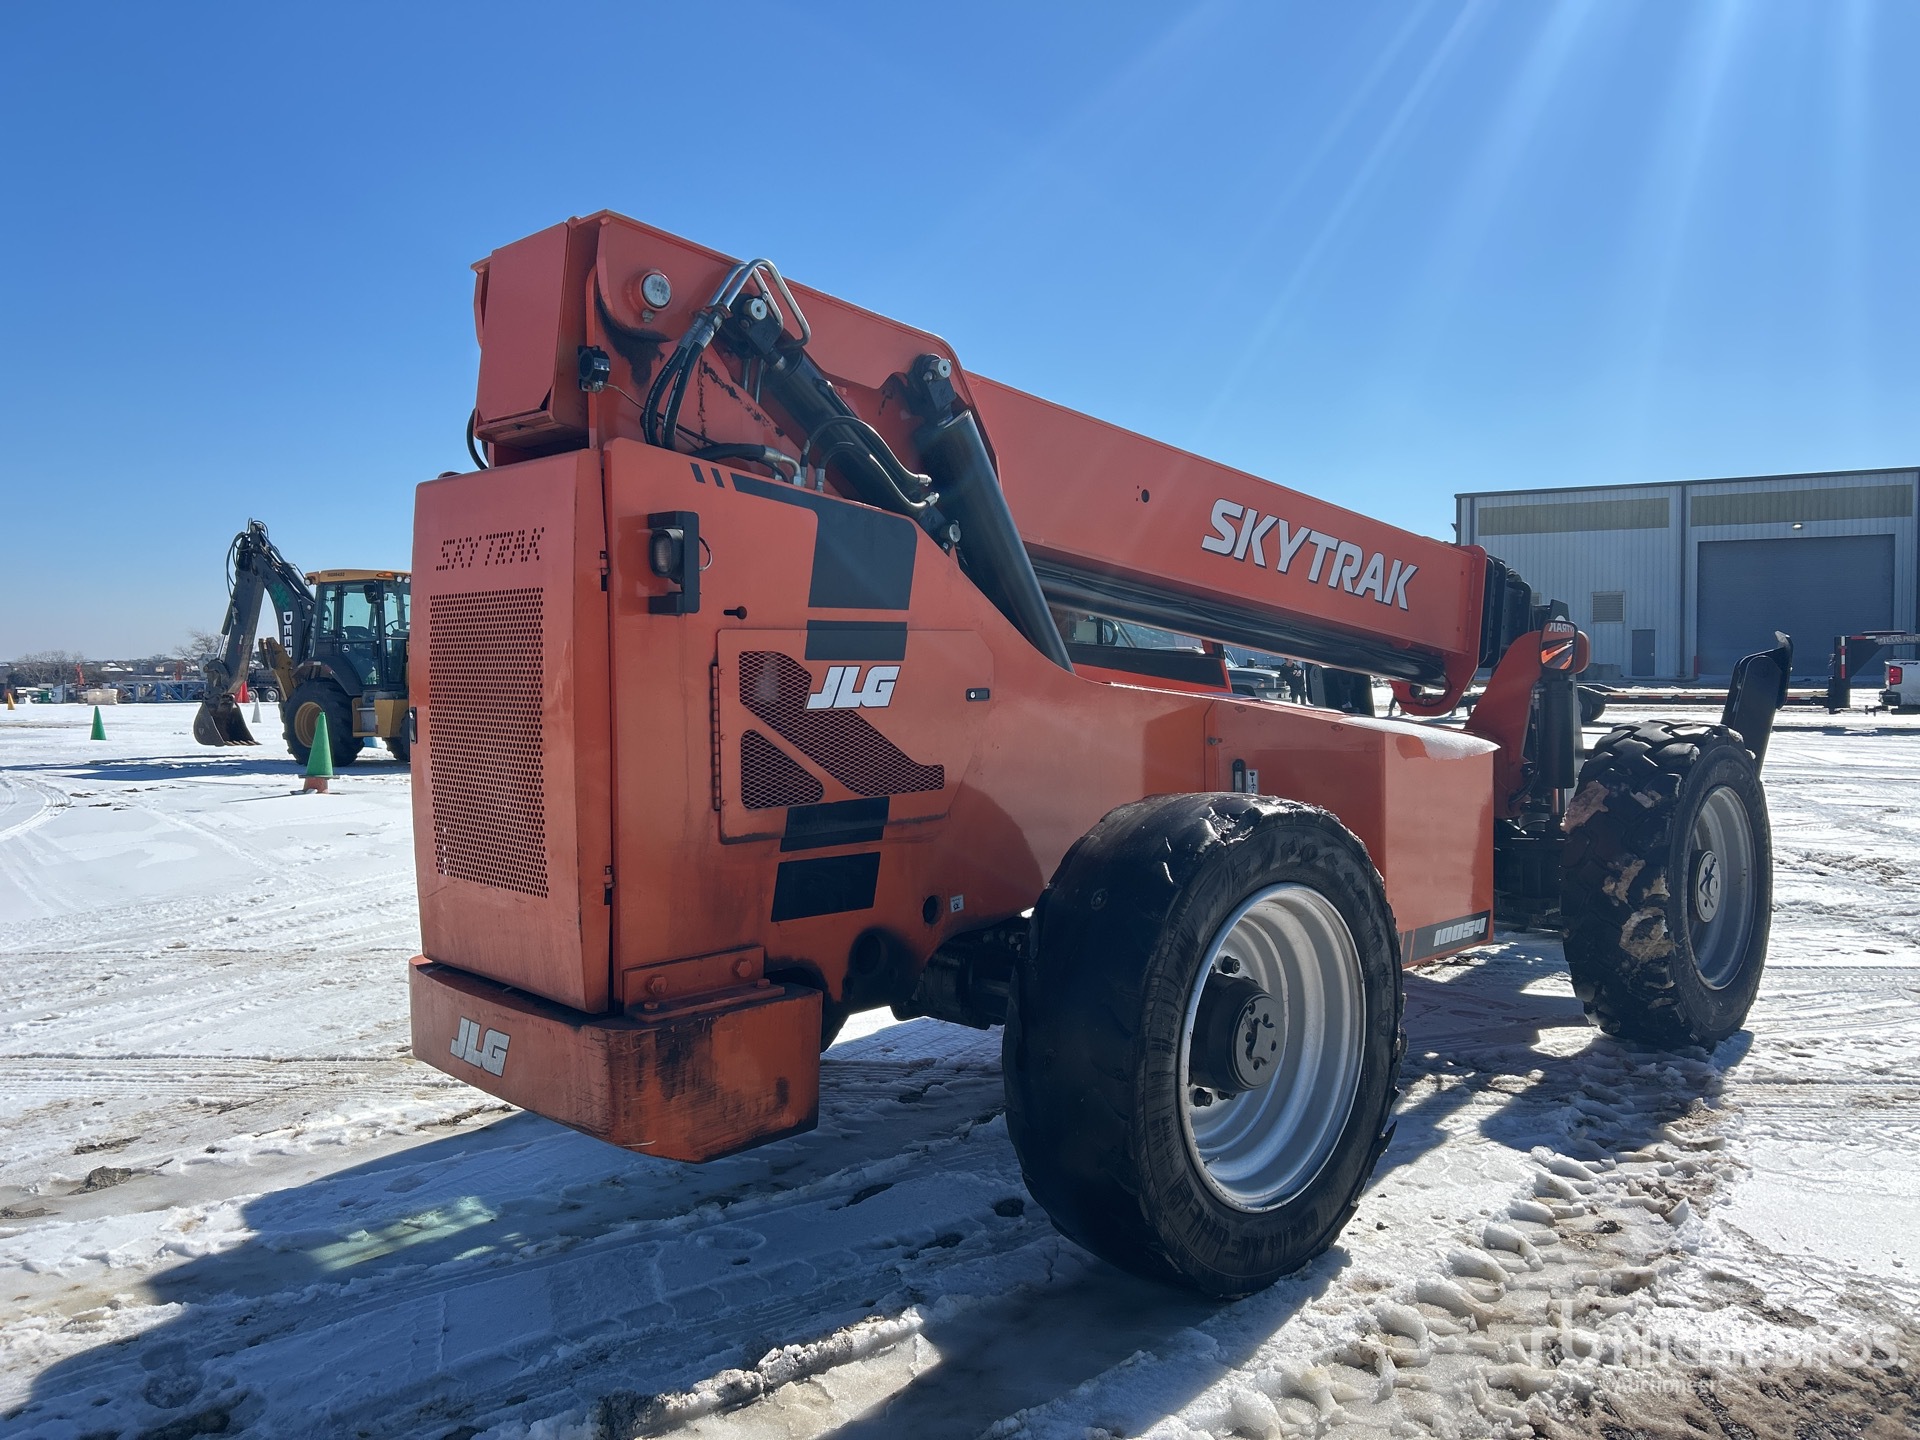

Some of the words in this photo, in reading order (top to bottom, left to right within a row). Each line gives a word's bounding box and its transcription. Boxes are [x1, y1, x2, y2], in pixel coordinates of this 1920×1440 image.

[435, 526, 545, 571] SKYTRAK
[1200, 497, 1419, 612] SKYTRAK
[805, 665, 901, 710] JLG
[1433, 917, 1487, 947] 10054
[450, 1016, 511, 1078] JLG
